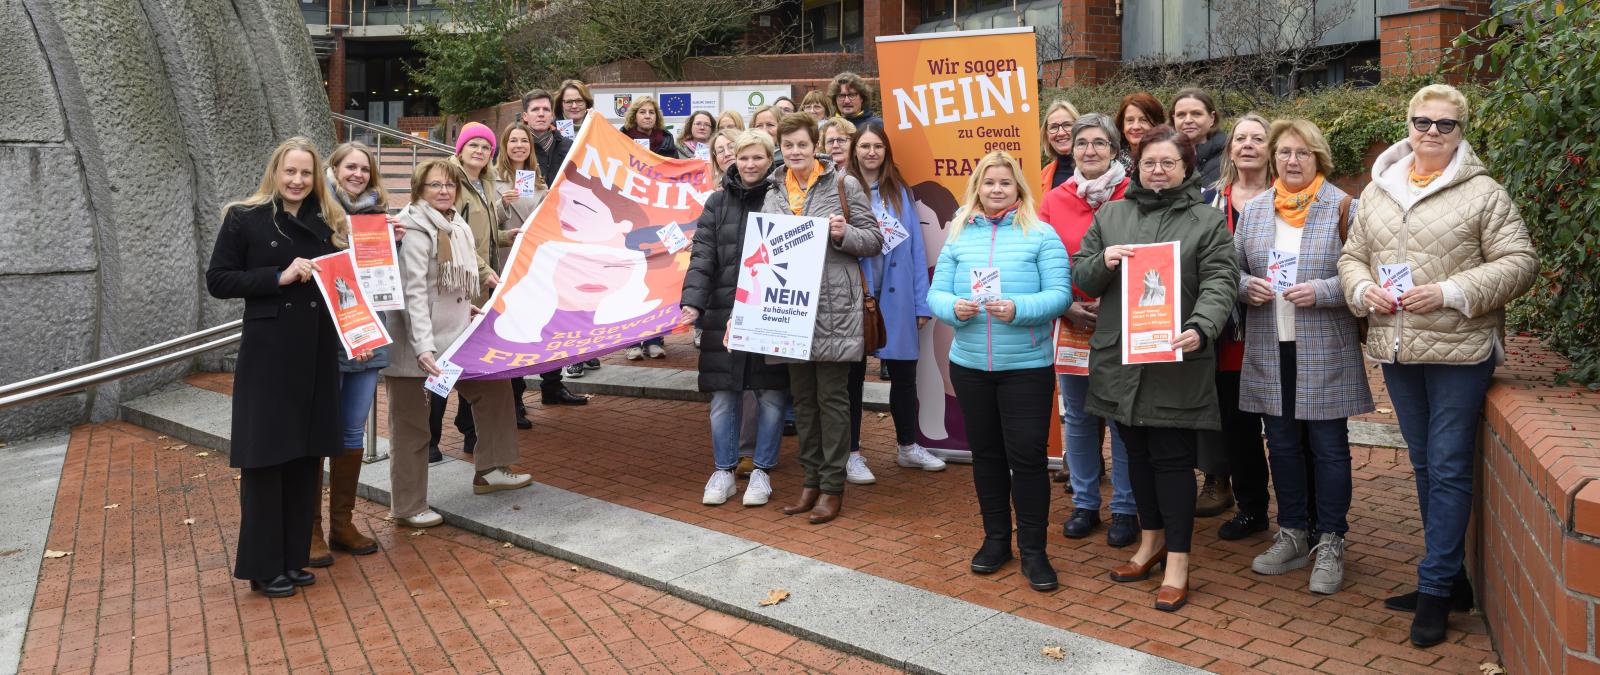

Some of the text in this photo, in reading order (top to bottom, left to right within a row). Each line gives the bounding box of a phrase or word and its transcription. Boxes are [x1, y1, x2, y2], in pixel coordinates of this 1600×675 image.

[928, 58, 1017, 77] Wir sagen
[892, 66, 1031, 130] NEIN!
[958, 125, 1021, 139] zu Gewalt
[984, 141, 1021, 154] gegen
[628, 153, 663, 180] Wir
[934, 157, 1023, 177] FRA!
[769, 219, 815, 247] WIR ERHEBEN
[772, 230, 815, 257] DIE STIMME!
[764, 286, 810, 307] NEIN
[761, 313, 790, 324] Gewalt!
[772, 305, 809, 317] häuslicher
[552, 306, 673, 340] zu Gewalt
